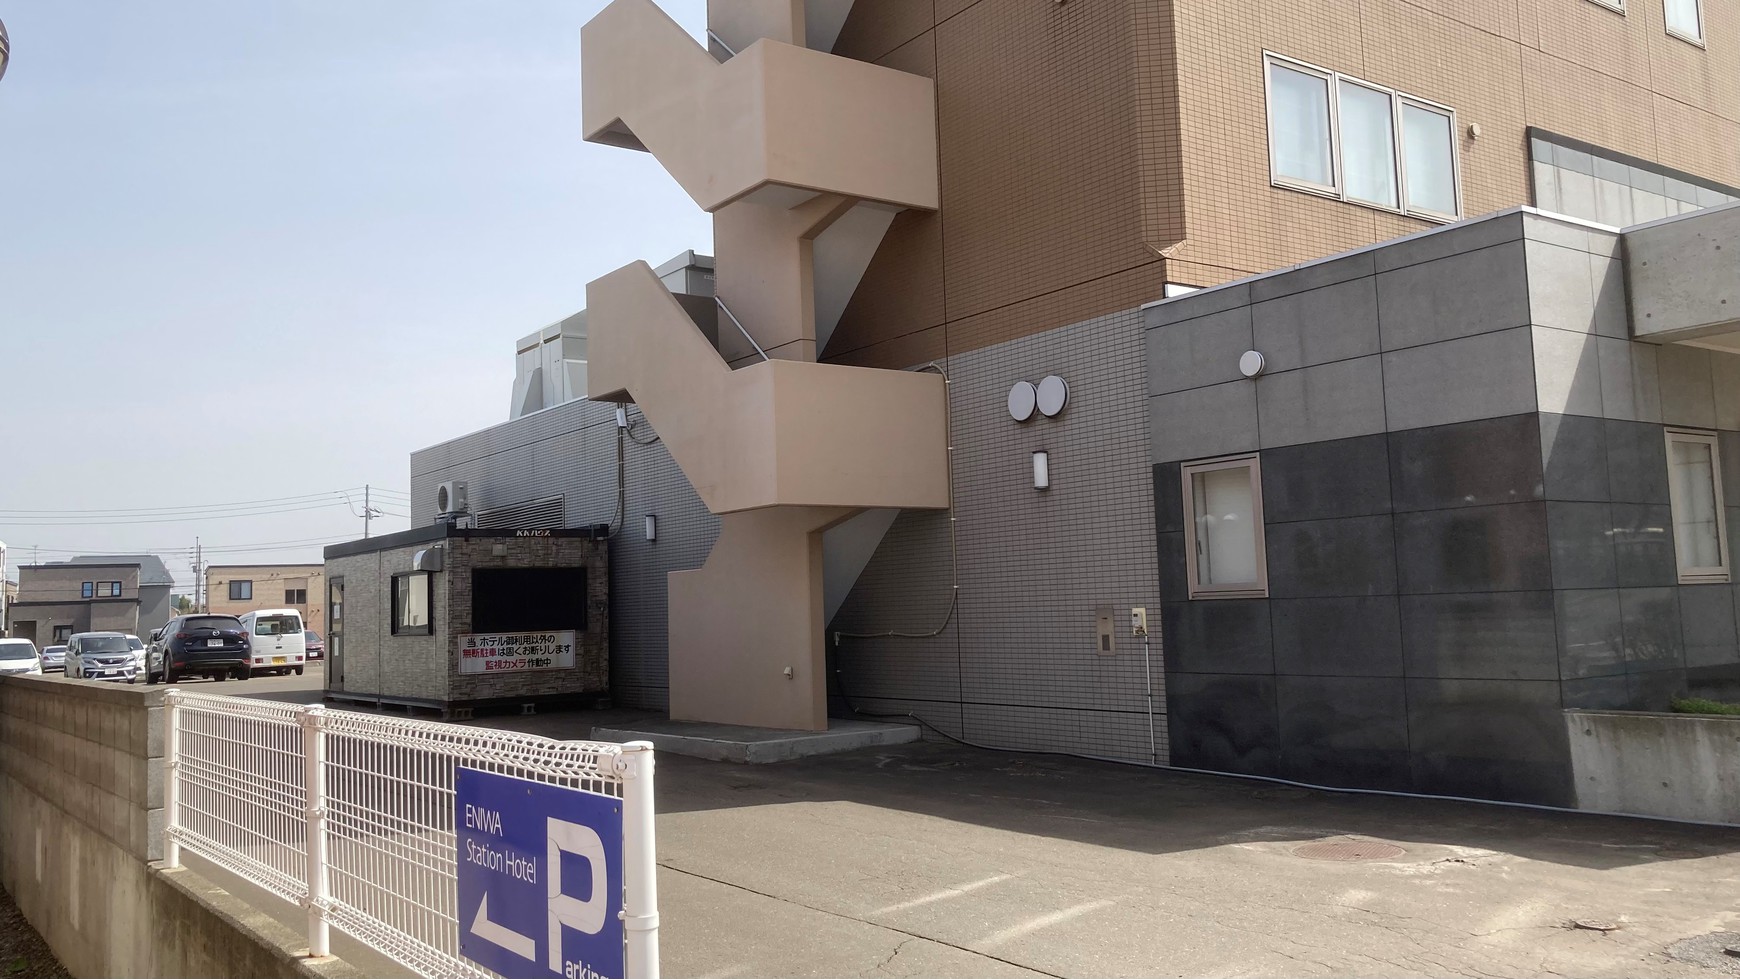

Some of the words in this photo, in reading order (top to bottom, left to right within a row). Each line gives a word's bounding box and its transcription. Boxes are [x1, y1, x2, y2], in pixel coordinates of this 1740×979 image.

[485, 658, 552, 670] 監視カメラ作動中
[465, 803, 502, 837] ENIWA
[466, 839, 503, 873] Station
[505, 850, 537, 884] Hotel
